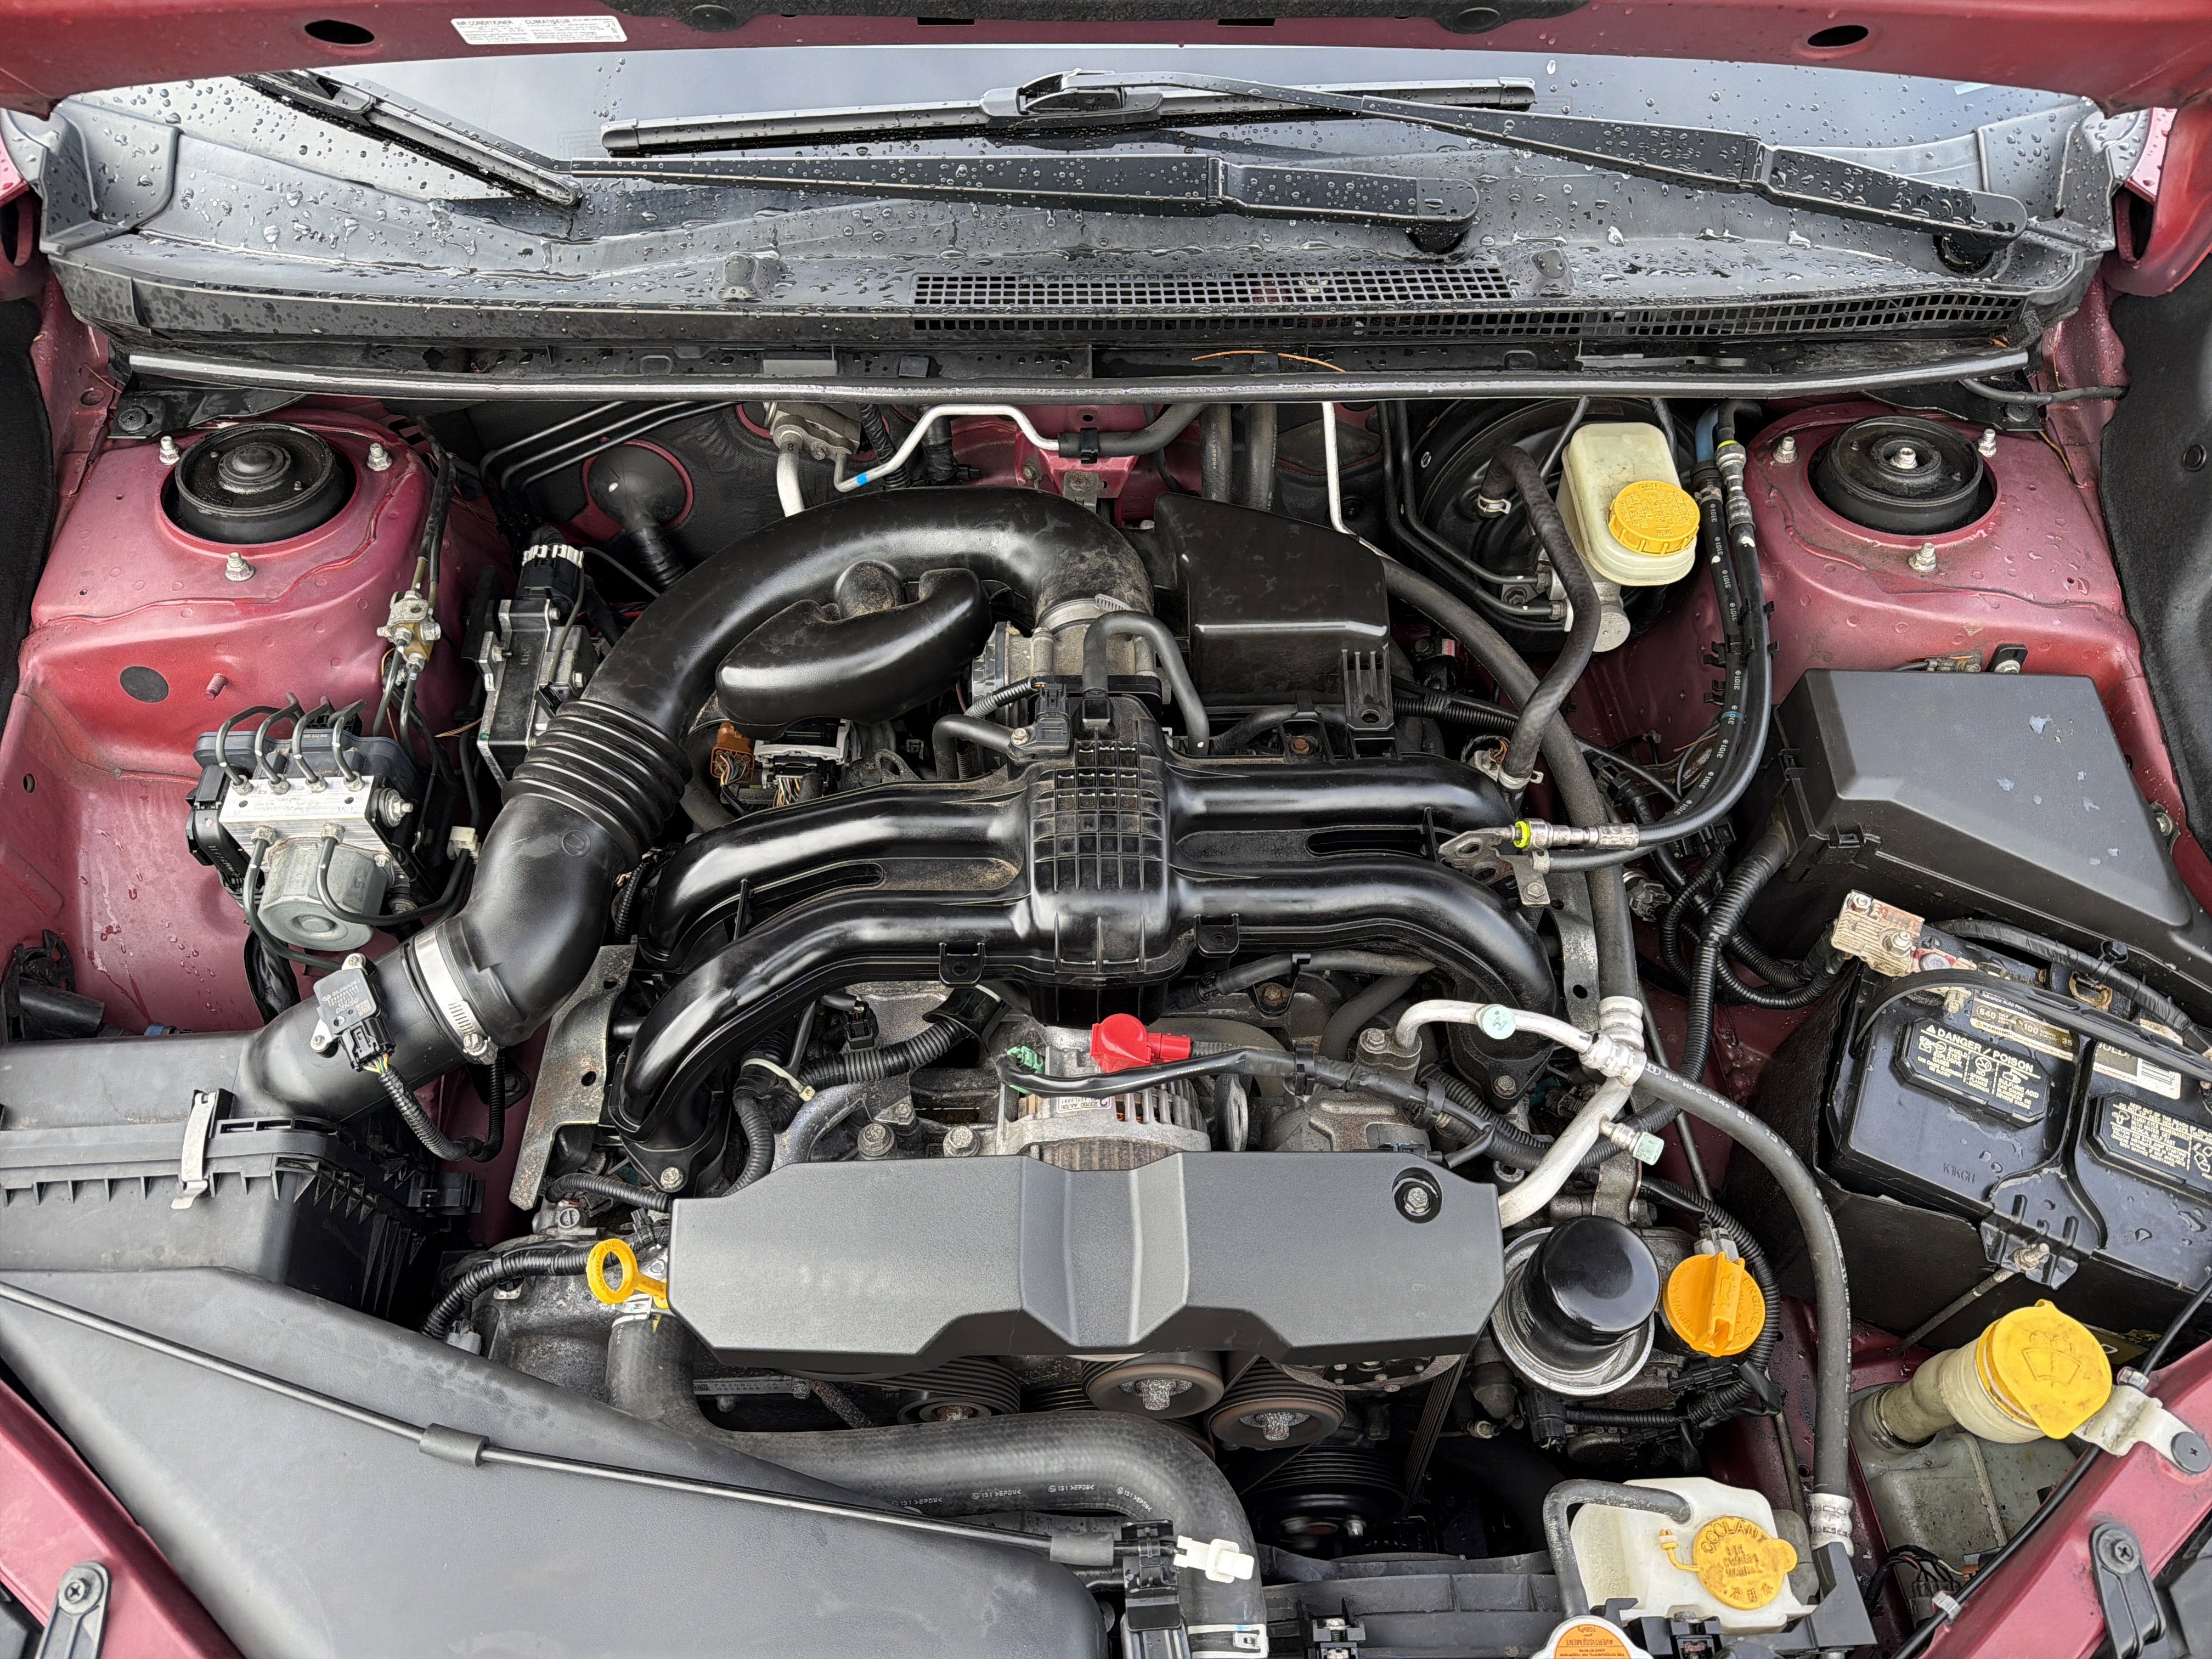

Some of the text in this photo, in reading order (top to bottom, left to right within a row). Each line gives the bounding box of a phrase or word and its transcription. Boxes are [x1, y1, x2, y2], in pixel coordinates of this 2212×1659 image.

[787, 443, 794, 452] 8
[1715, 540, 1723, 556] 3101
[1723, 574, 1731, 589] 3101
[1716, 744, 1727, 758] 3101
[1699, 775, 1711, 789] 3101
[1674, 804, 1689, 816] 3101
[335, 997, 359, 1014] DENSO
[1982, 994, 2002, 1003] Advance
[1979, 1008, 1996, 1019] 640
[2024, 1023, 2039, 1035] 100
[2062, 1037, 2073, 1046] 35
[1938, 1028, 1982, 1052] DANGER
[1993, 1050, 2034, 1073] POISON
[1947, 1052, 1961, 1061] EYES
[1948, 1046, 1968, 1058] SHIELD
[1932, 1057, 1950, 1068] GASES
[1933, 1051, 1962, 1066] EXPLOSIVE
[1999, 1077, 2039, 1098] SULFURIC ACID
[1665, 1073, 1679, 1083] HP
[1683, 1081, 1730, 1109] HFC-134a
[1765, 1129, 1778, 1143] 13
[2131, 1114, 2191, 1141] FLUSH EYES IMMEDIATELY
[2131, 1120, 2143, 1128] WITH
[2162, 1131, 2171, 1139] GET
[2131, 1125, 2176, 1147] MEDICAL HELP FAST
[1735, 1278, 1764, 1341] ENGINE OIL
[1701, 1520, 1769, 1554] COOLANT
